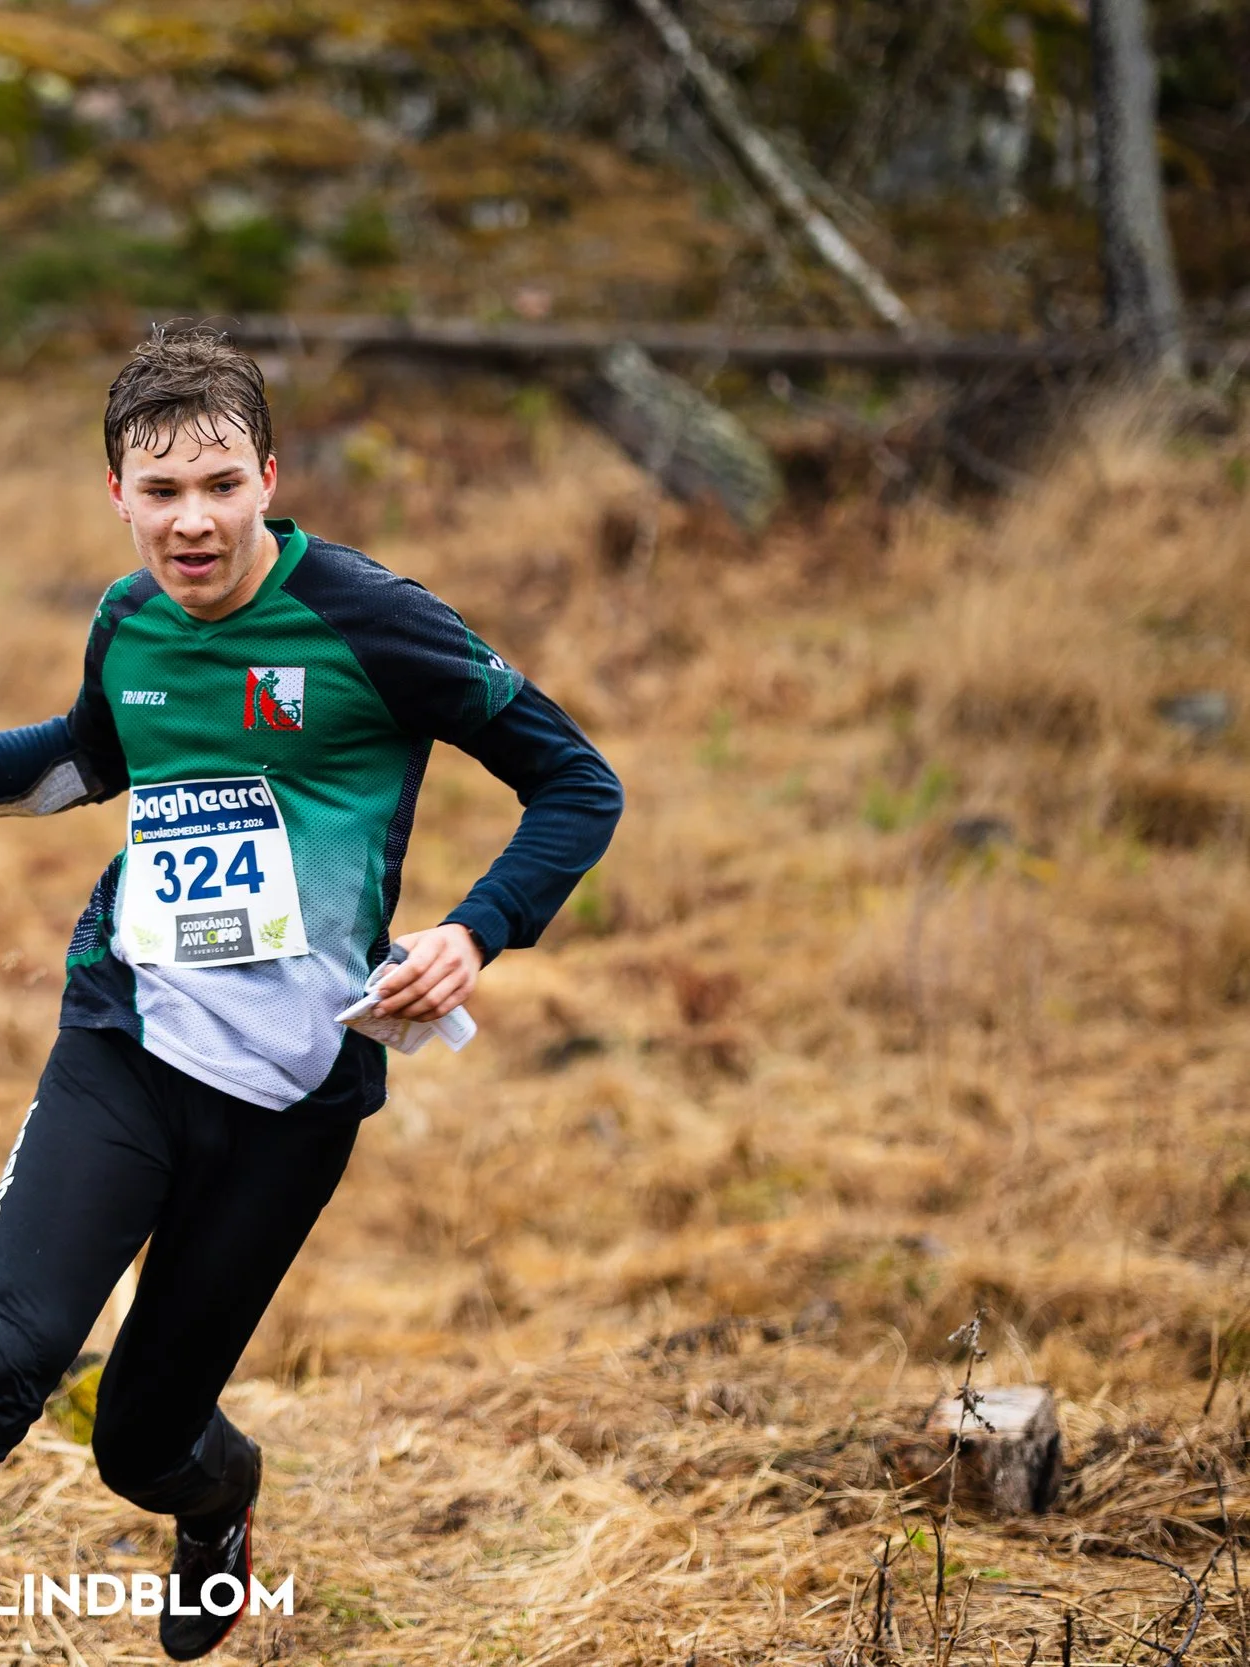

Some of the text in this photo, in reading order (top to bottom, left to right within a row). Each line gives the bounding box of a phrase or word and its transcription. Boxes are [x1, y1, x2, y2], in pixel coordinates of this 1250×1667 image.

[121, 690, 168, 706] TRIMTEX
[132, 787, 272, 822] bagheera
[142, 824, 211, 840] KOLMÅRDSMEDELN
[216, 822, 228, 832] SL
[228, 820, 242, 831] #2
[242, 818, 265, 829] 2026
[152, 839, 265, 904] 324
[180, 916, 243, 932] GODKÄNDA
[181, 926, 242, 947] AVLOPP
[193, 946, 225, 955] SVERIGE
